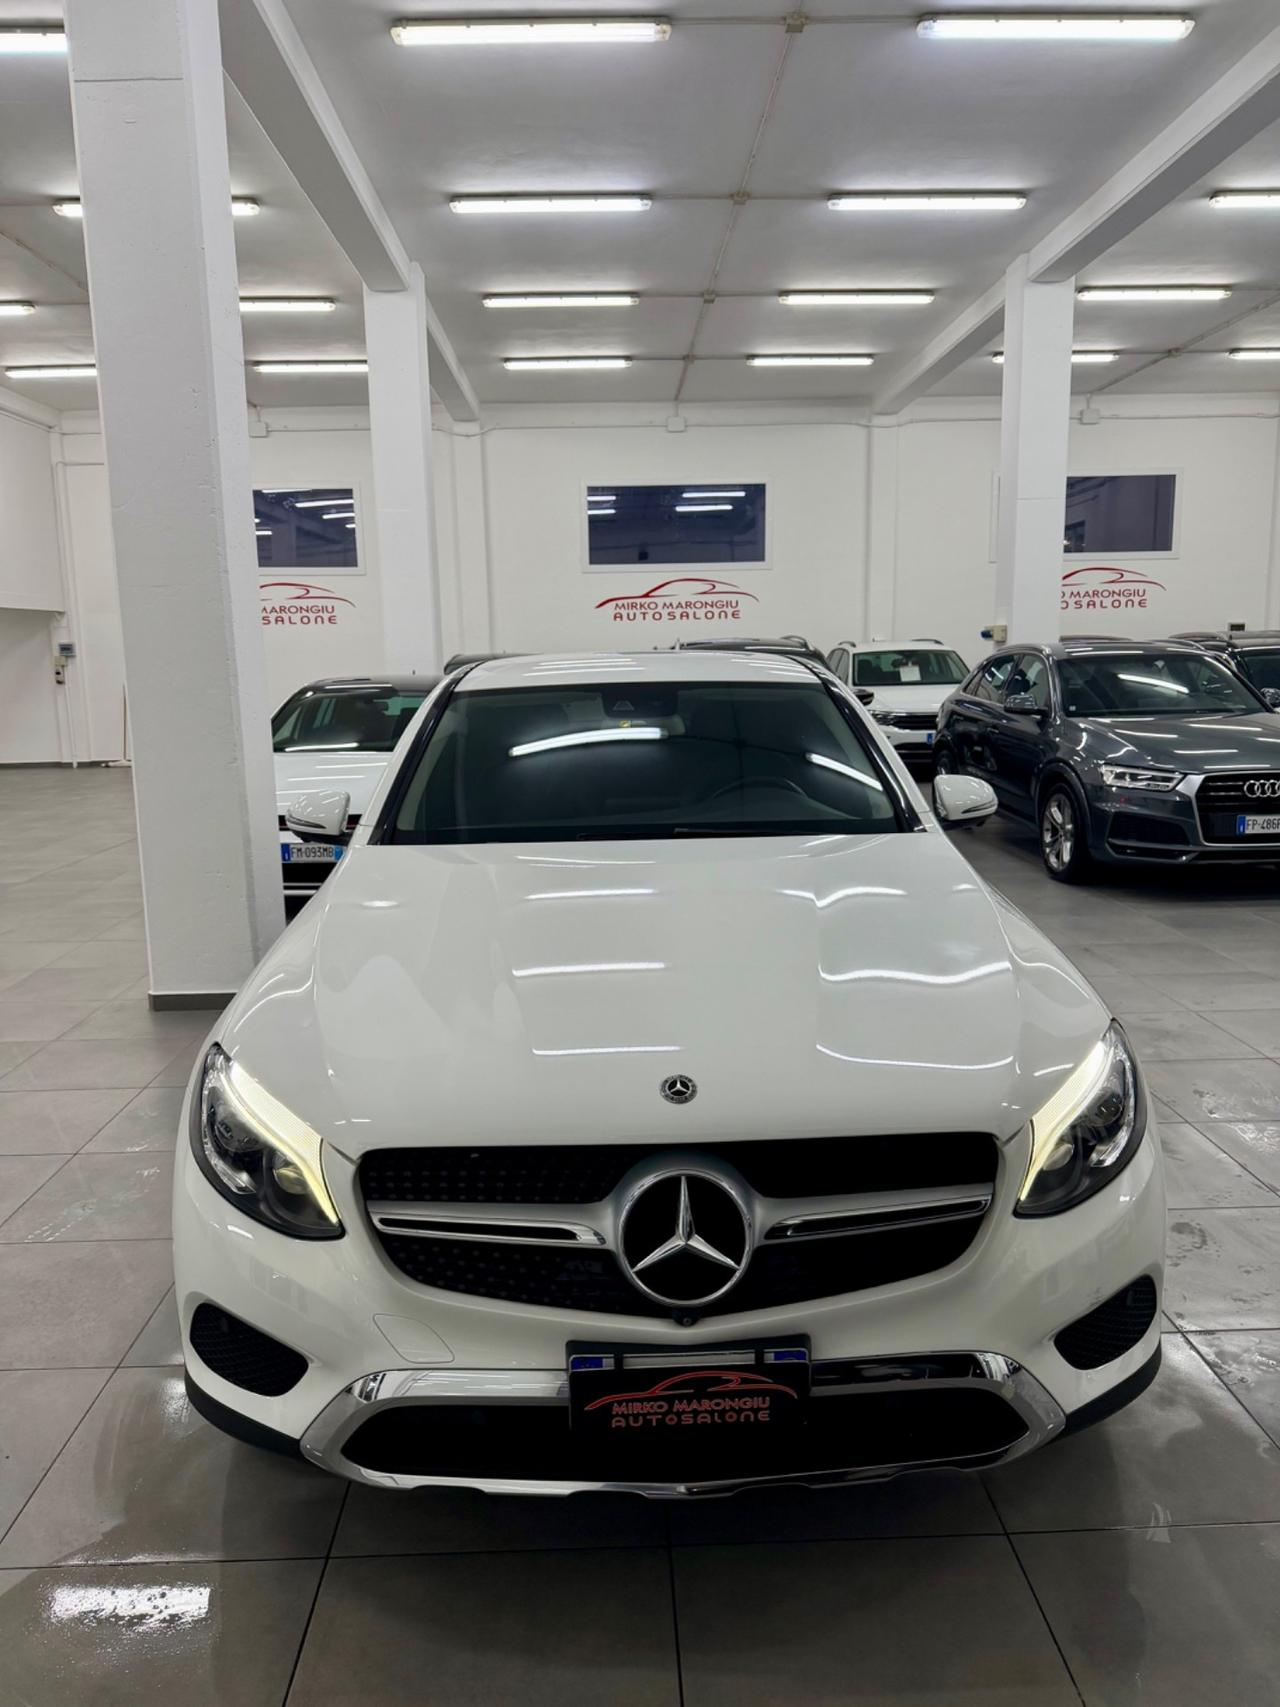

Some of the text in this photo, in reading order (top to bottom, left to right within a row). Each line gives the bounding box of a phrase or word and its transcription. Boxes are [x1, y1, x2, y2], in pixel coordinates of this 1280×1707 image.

[1069, 588, 1146, 599] MARONGIU
[614, 600, 739, 611] MIRKO MARONGIU
[613, 610, 741, 622] AUTOSALONE
[612, 1396, 770, 1415] MIRKO MARONGIU
[611, 1411, 771, 1428] AUTOSALONE
